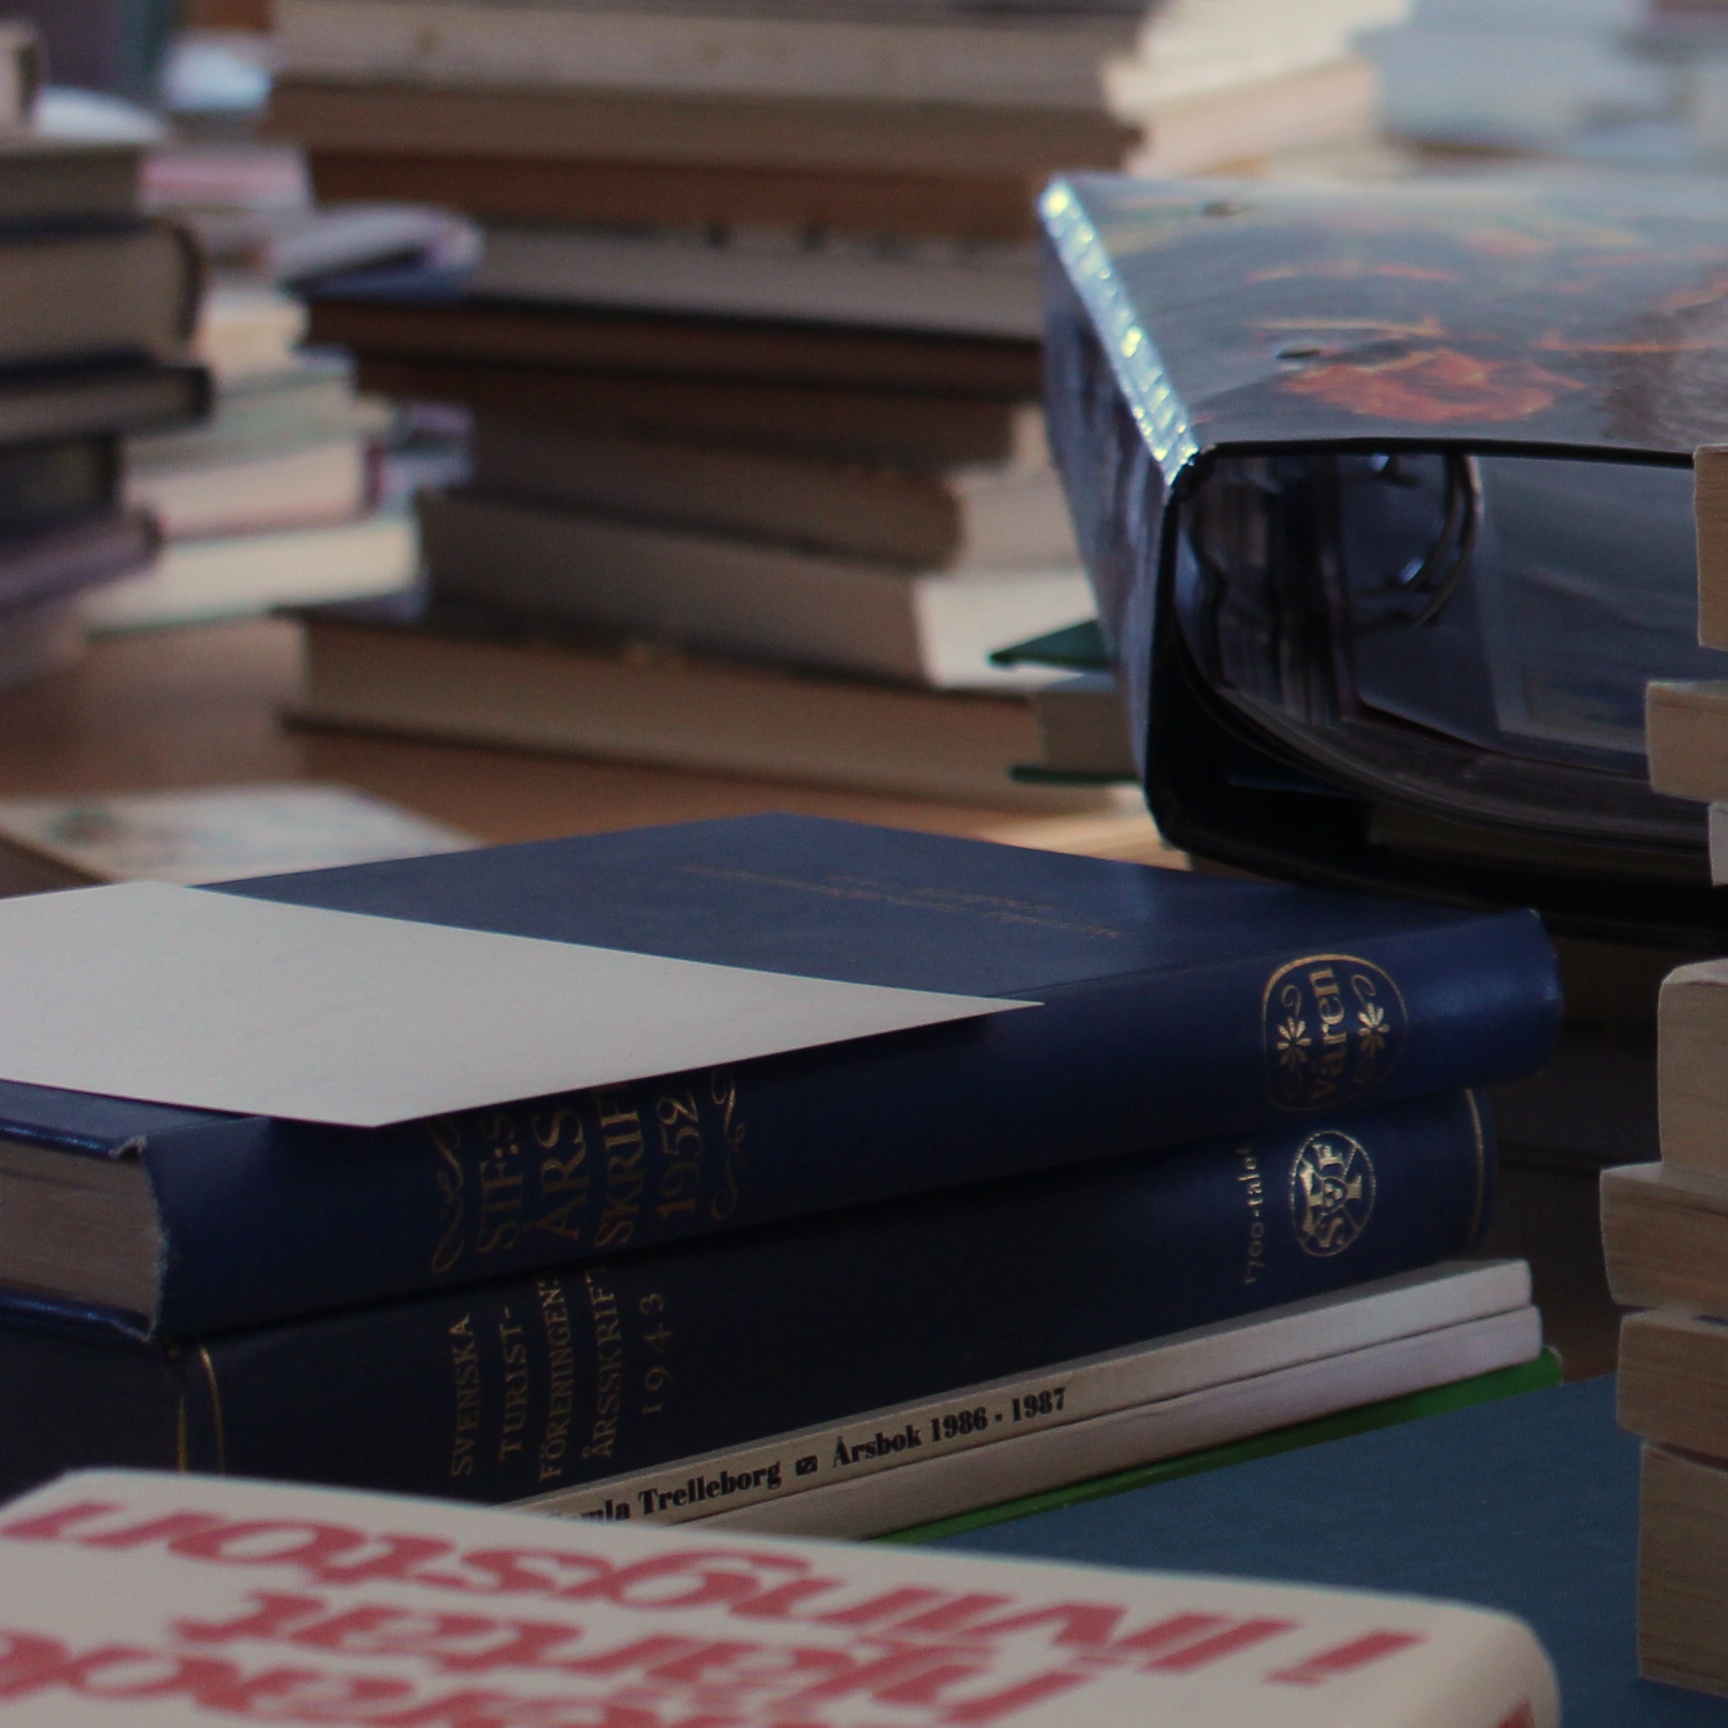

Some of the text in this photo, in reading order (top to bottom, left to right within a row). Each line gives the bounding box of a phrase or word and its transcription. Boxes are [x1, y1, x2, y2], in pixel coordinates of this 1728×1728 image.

[655, 1091, 703, 1220] 1952
[449, 1312, 481, 1478] SVENSKA
[498, 1303, 529, 1462] TURIST-
[638, 1292, 673, 1416] 1943
[638, 1461, 783, 1515] Trelleborg
[831, 1434, 923, 1469] Årsbok
[929, 1405, 989, 1442] 1986
[1011, 1386, 1067, 1424] 1987
